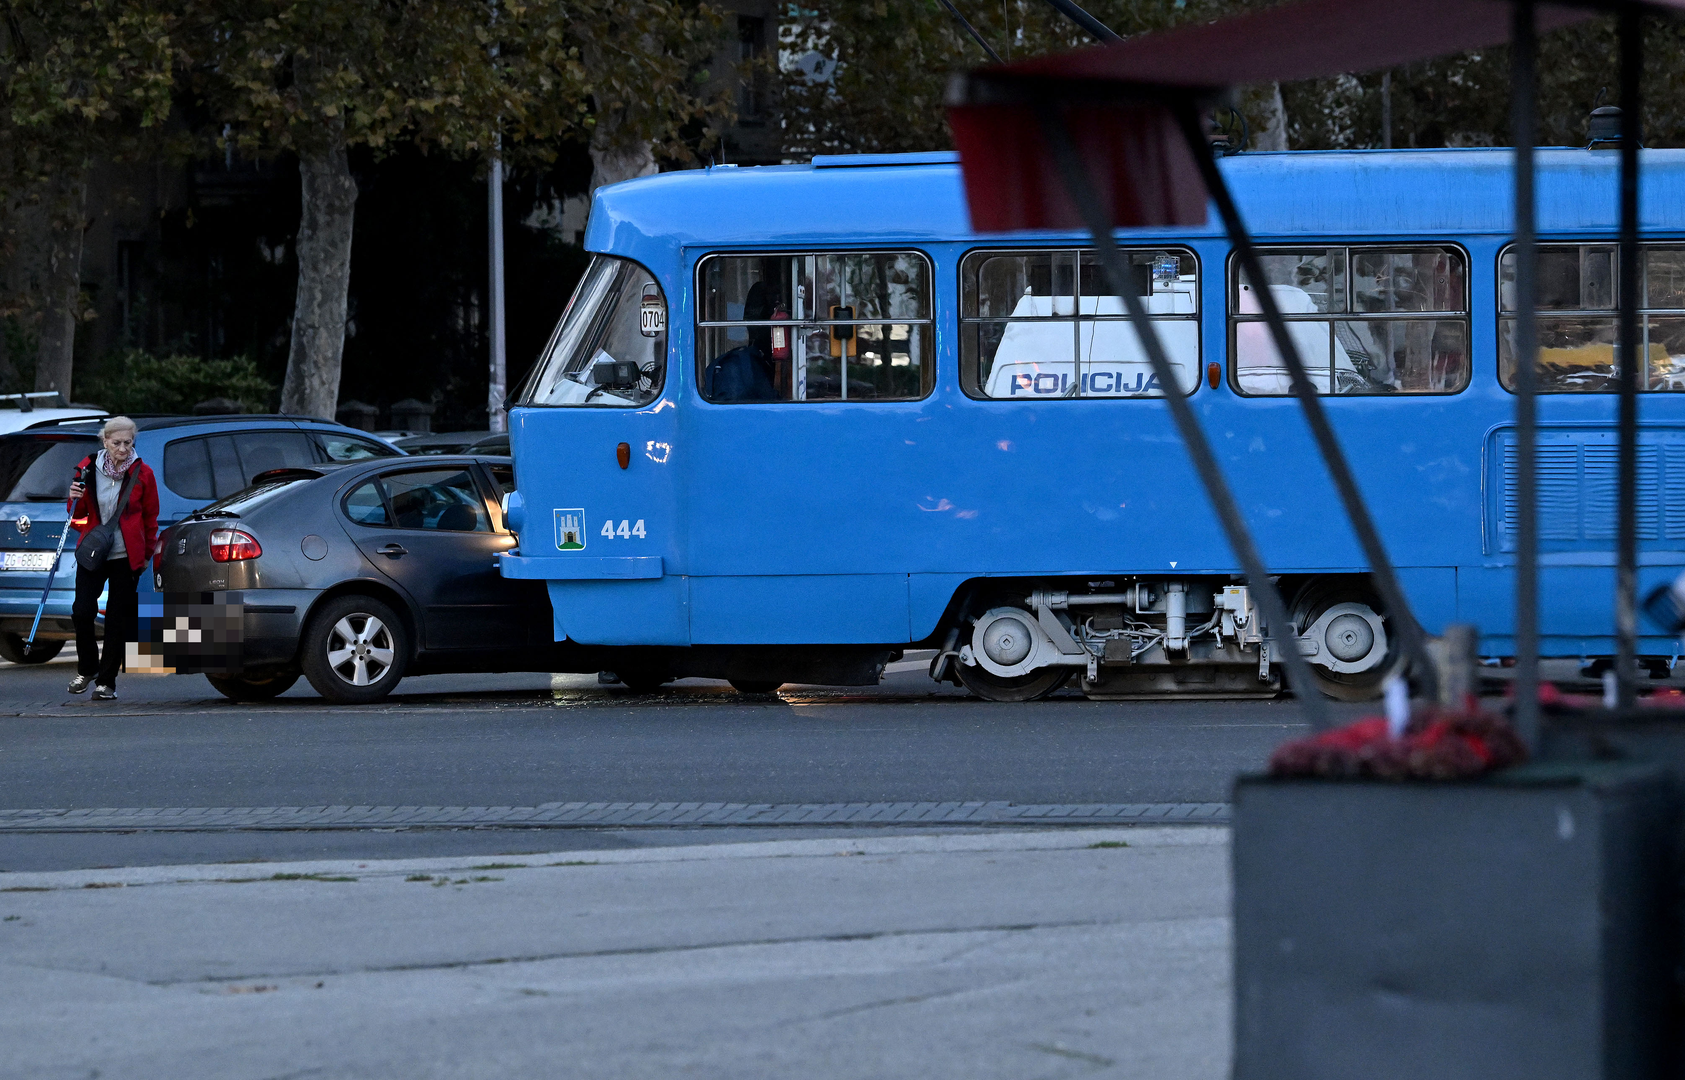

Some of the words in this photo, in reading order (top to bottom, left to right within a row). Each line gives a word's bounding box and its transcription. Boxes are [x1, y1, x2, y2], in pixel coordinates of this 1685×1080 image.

[642, 311, 665, 328] 0704
[601, 519, 647, 539] 444
[4, 553, 16, 567] ZG
